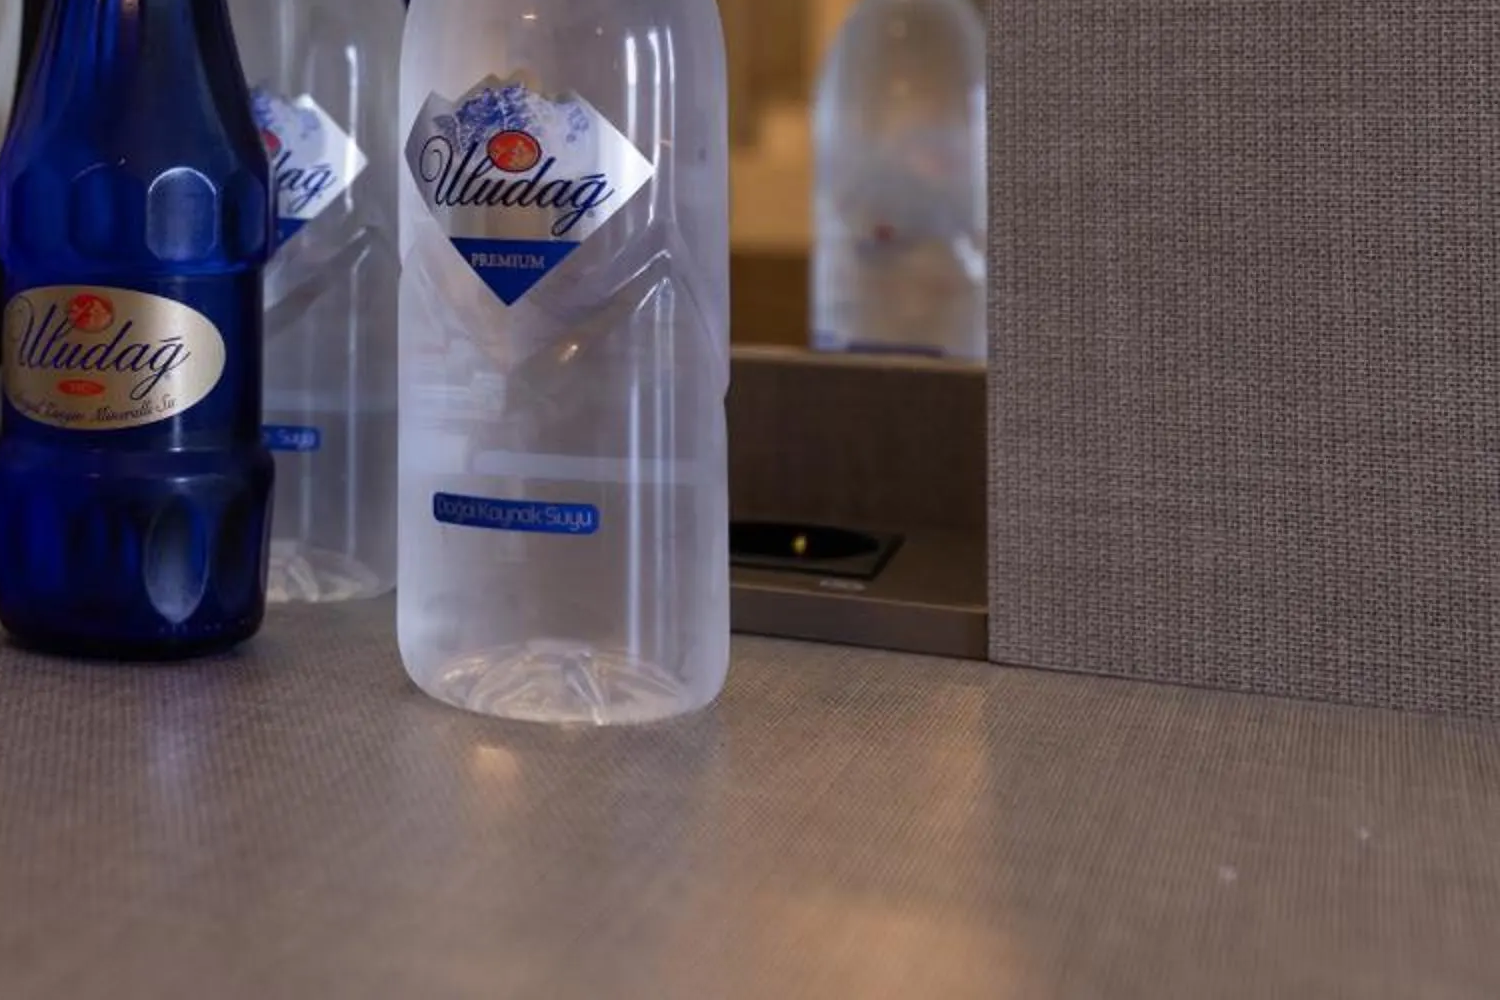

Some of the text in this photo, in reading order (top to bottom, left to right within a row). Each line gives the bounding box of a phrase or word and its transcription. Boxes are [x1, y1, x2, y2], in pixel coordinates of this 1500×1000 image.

[419, 135, 615, 237] Uludağ
[471, 252, 545, 269] PREMIUM
[8, 296, 190, 400] Uludağ
[478, 504, 541, 527] Kaynak
[546, 507, 592, 531] Suyu
